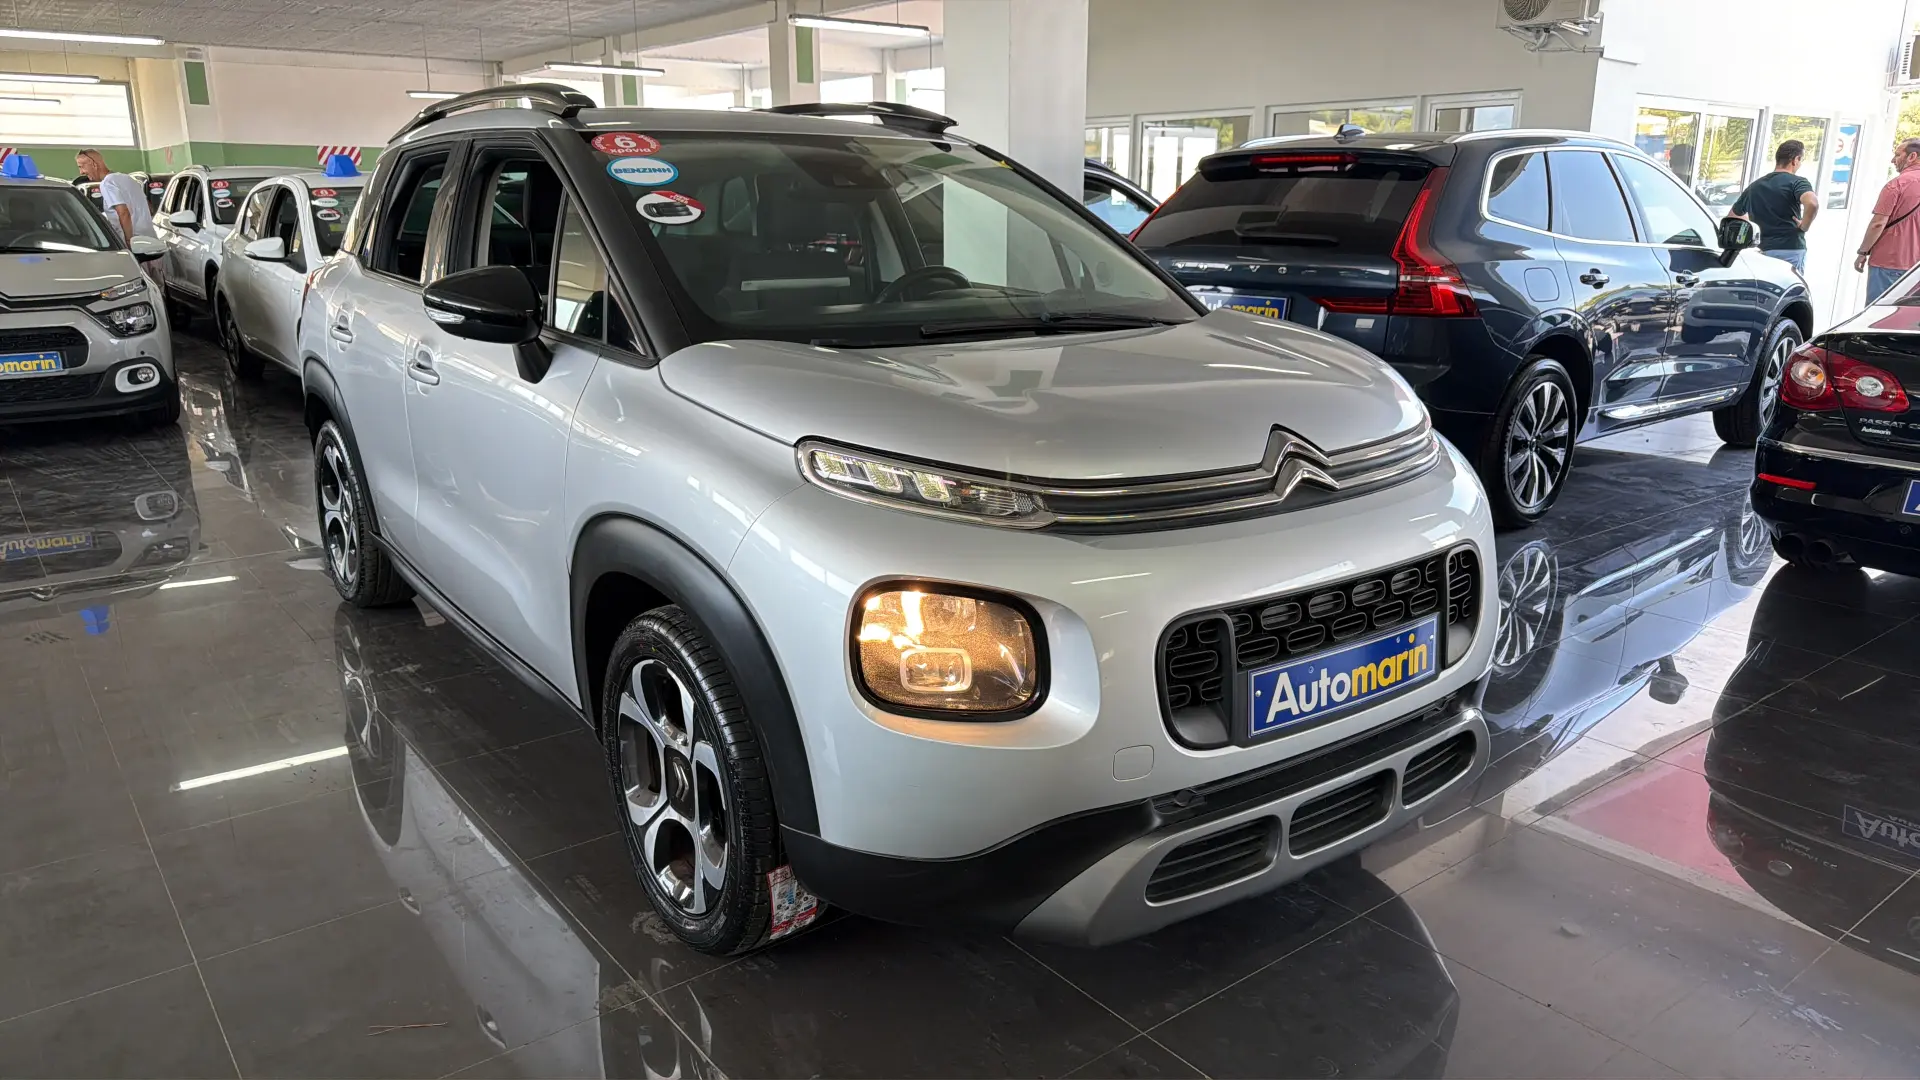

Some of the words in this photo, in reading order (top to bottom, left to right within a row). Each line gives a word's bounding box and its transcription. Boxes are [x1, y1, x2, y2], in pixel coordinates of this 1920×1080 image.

[614, 136, 637, 149] 6
[1859, 417, 1906, 429] PASSAT
[1860, 426, 1892, 436] Automarin
[1265, 633, 1428, 724] Automarin
